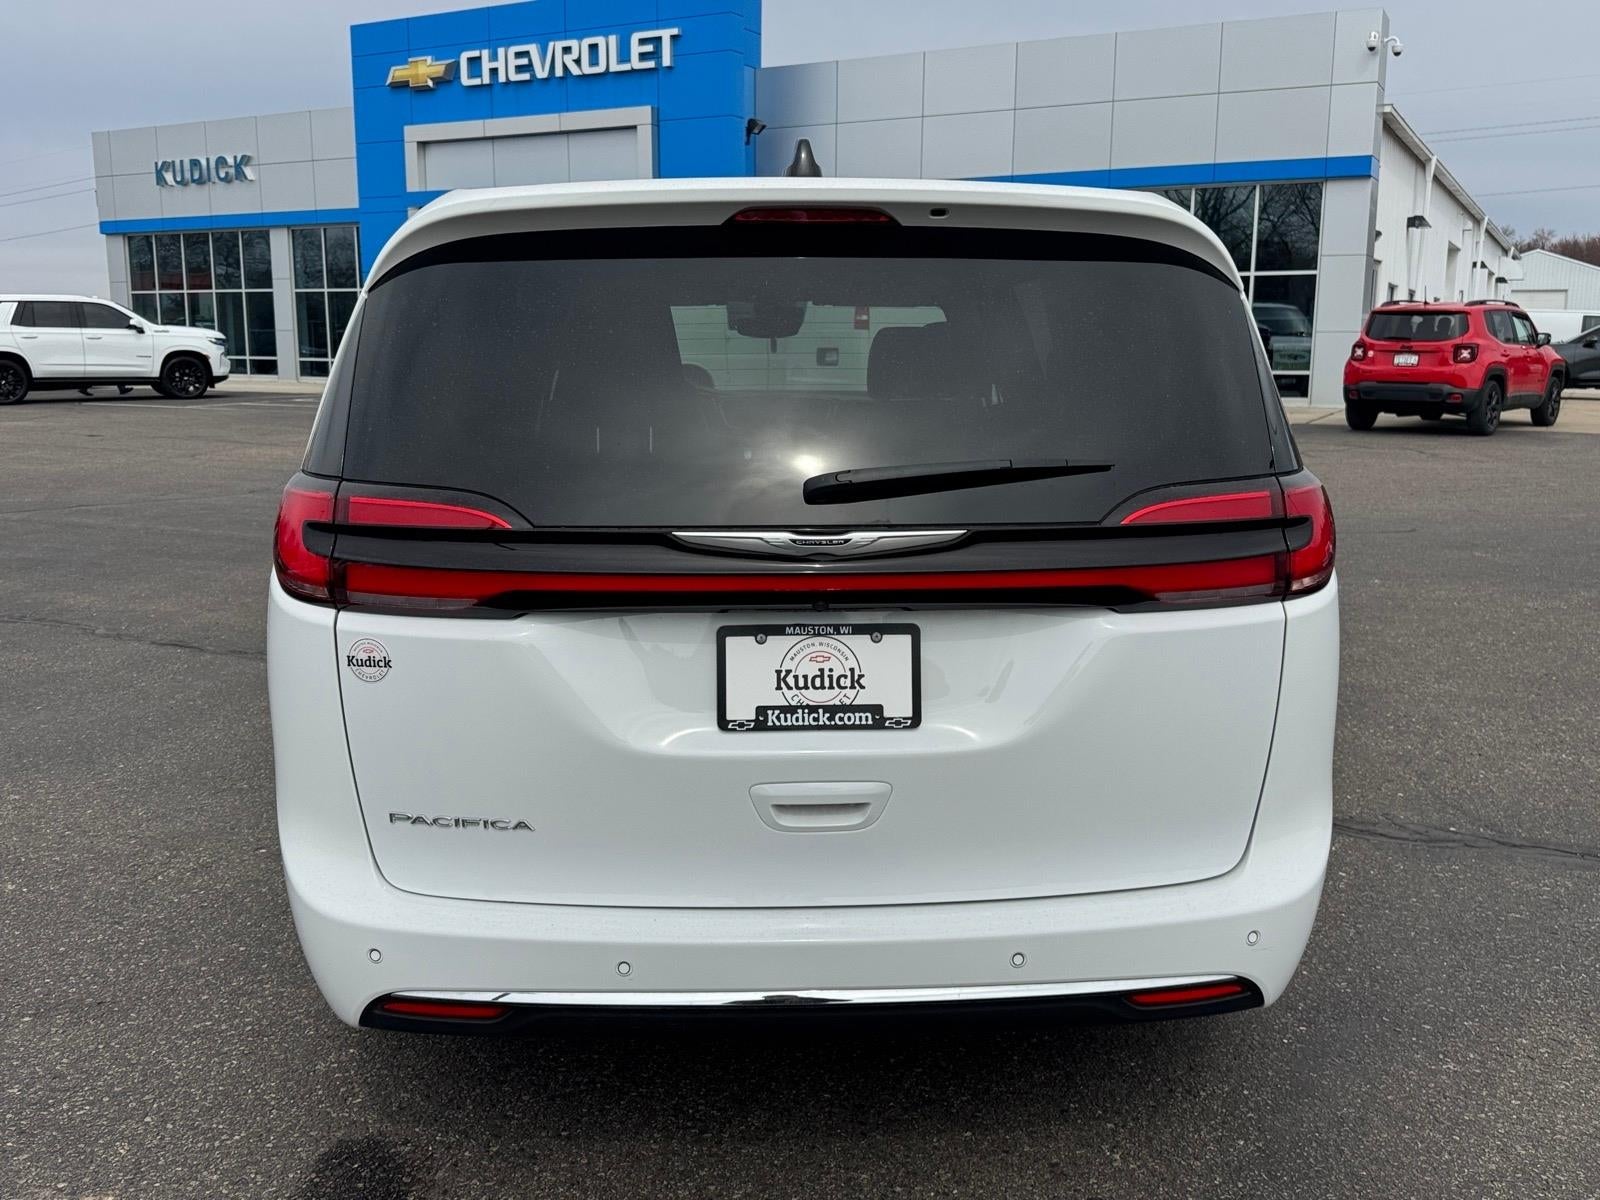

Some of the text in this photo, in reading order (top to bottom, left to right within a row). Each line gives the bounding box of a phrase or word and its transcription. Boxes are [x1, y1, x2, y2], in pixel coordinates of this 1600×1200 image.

[460, 28, 681, 87] CHEVROLET
[154, 154, 255, 187] KUDICK
[785, 625, 853, 636] MAUSTON, WI
[818, 641, 850, 662] WISCONSIN
[346, 655, 392, 669] Kudick
[775, 667, 866, 691] Kudick
[767, 709, 873, 727] Kudick.com
[388, 812, 536, 832] PACIFICA
